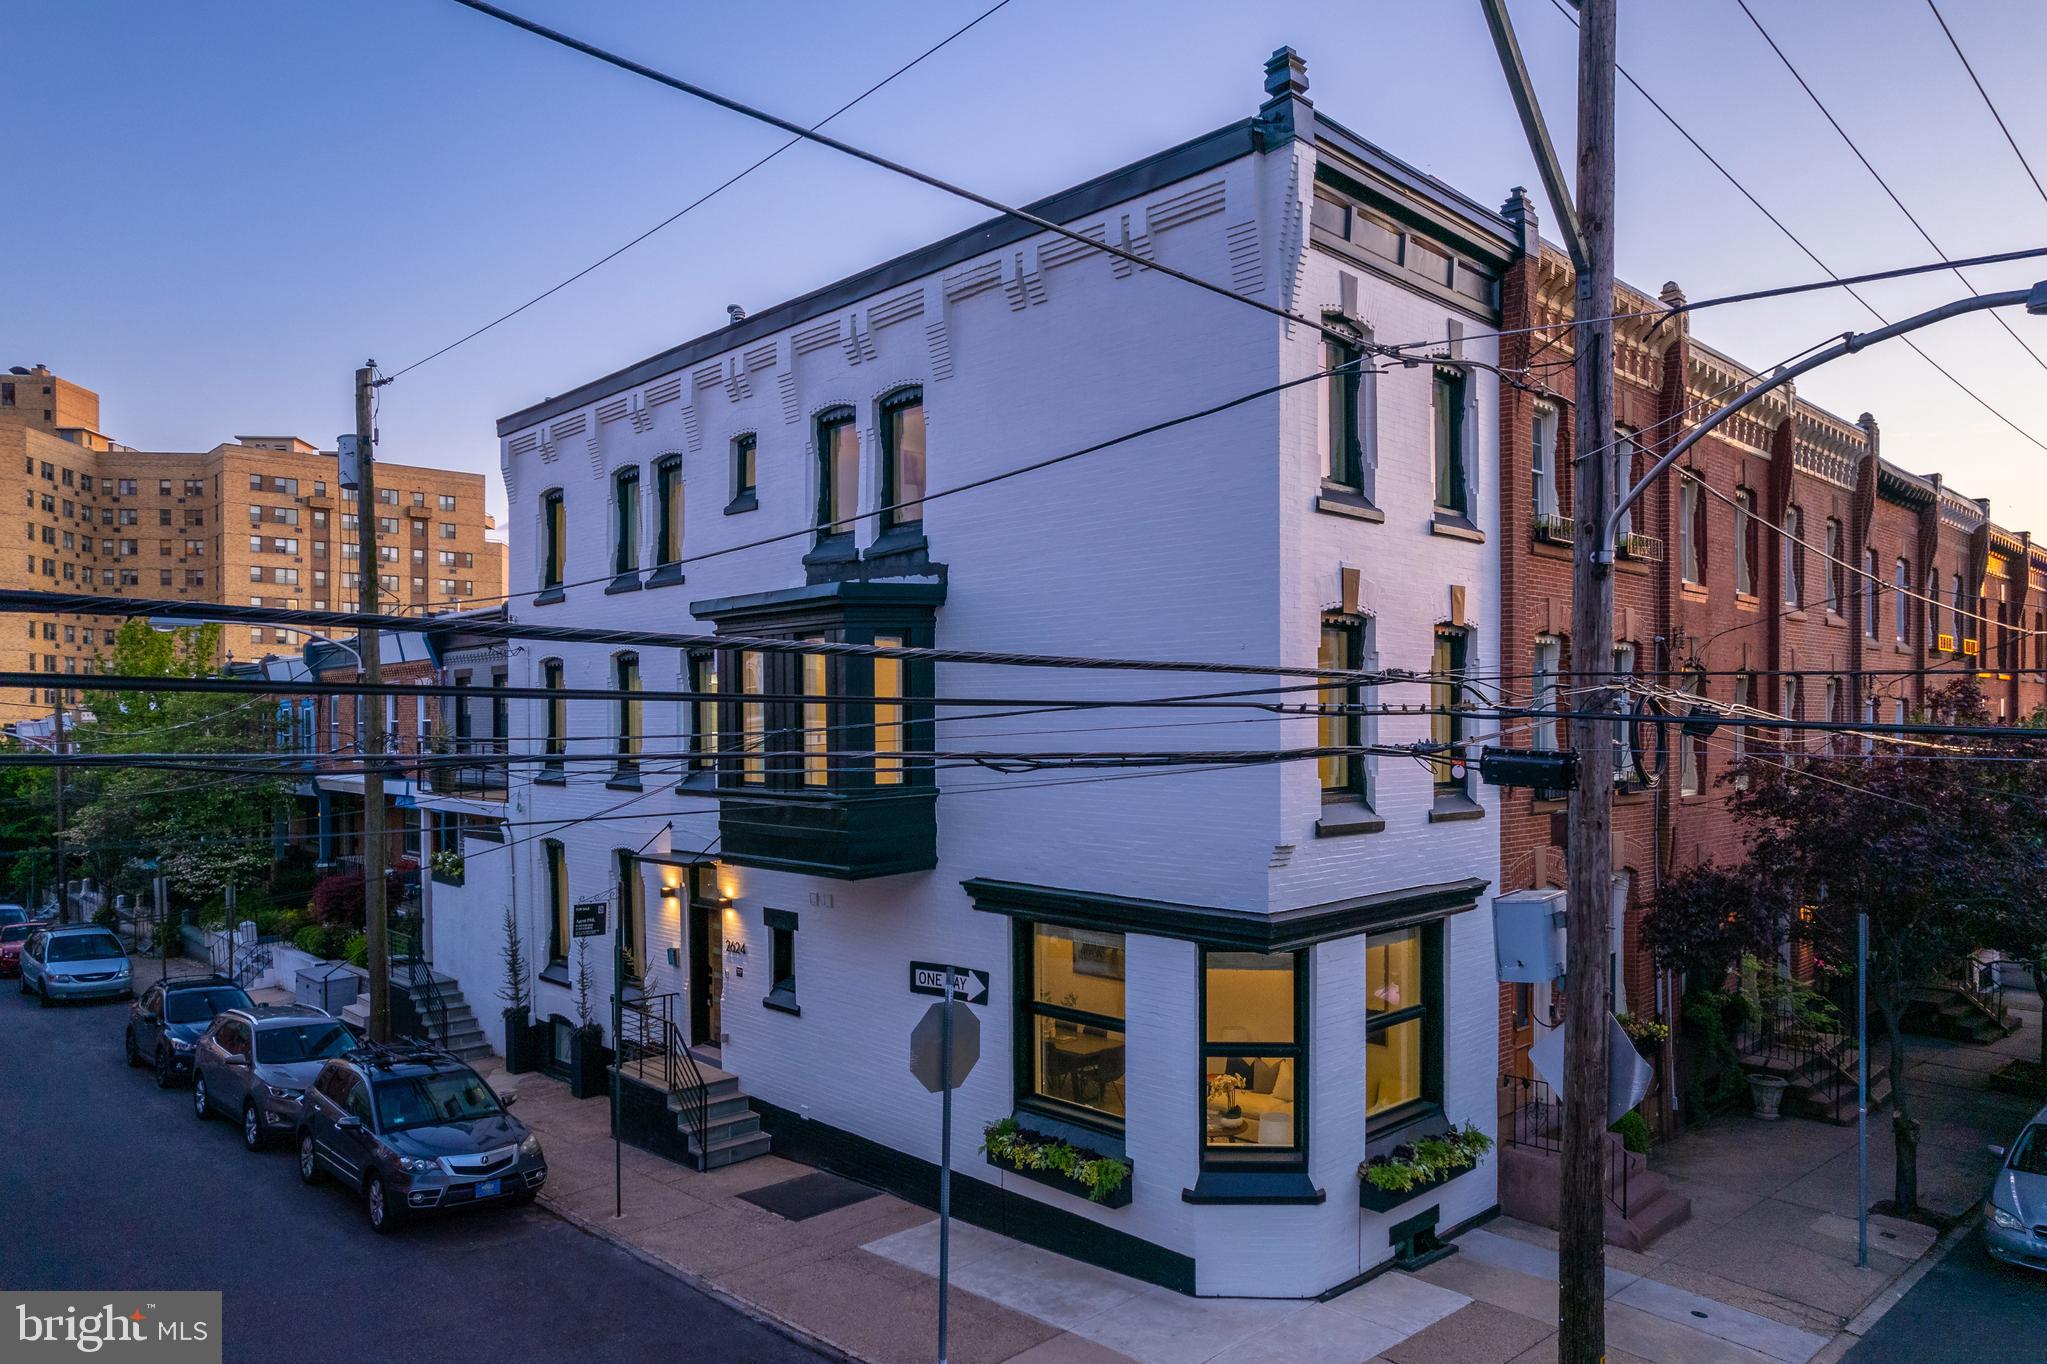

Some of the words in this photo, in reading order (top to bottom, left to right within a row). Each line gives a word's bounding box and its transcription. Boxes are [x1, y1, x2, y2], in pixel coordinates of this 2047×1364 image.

[726, 939, 746, 954] 2624
[919, 971, 942, 987] ONE
[953, 976, 967, 991] AY
